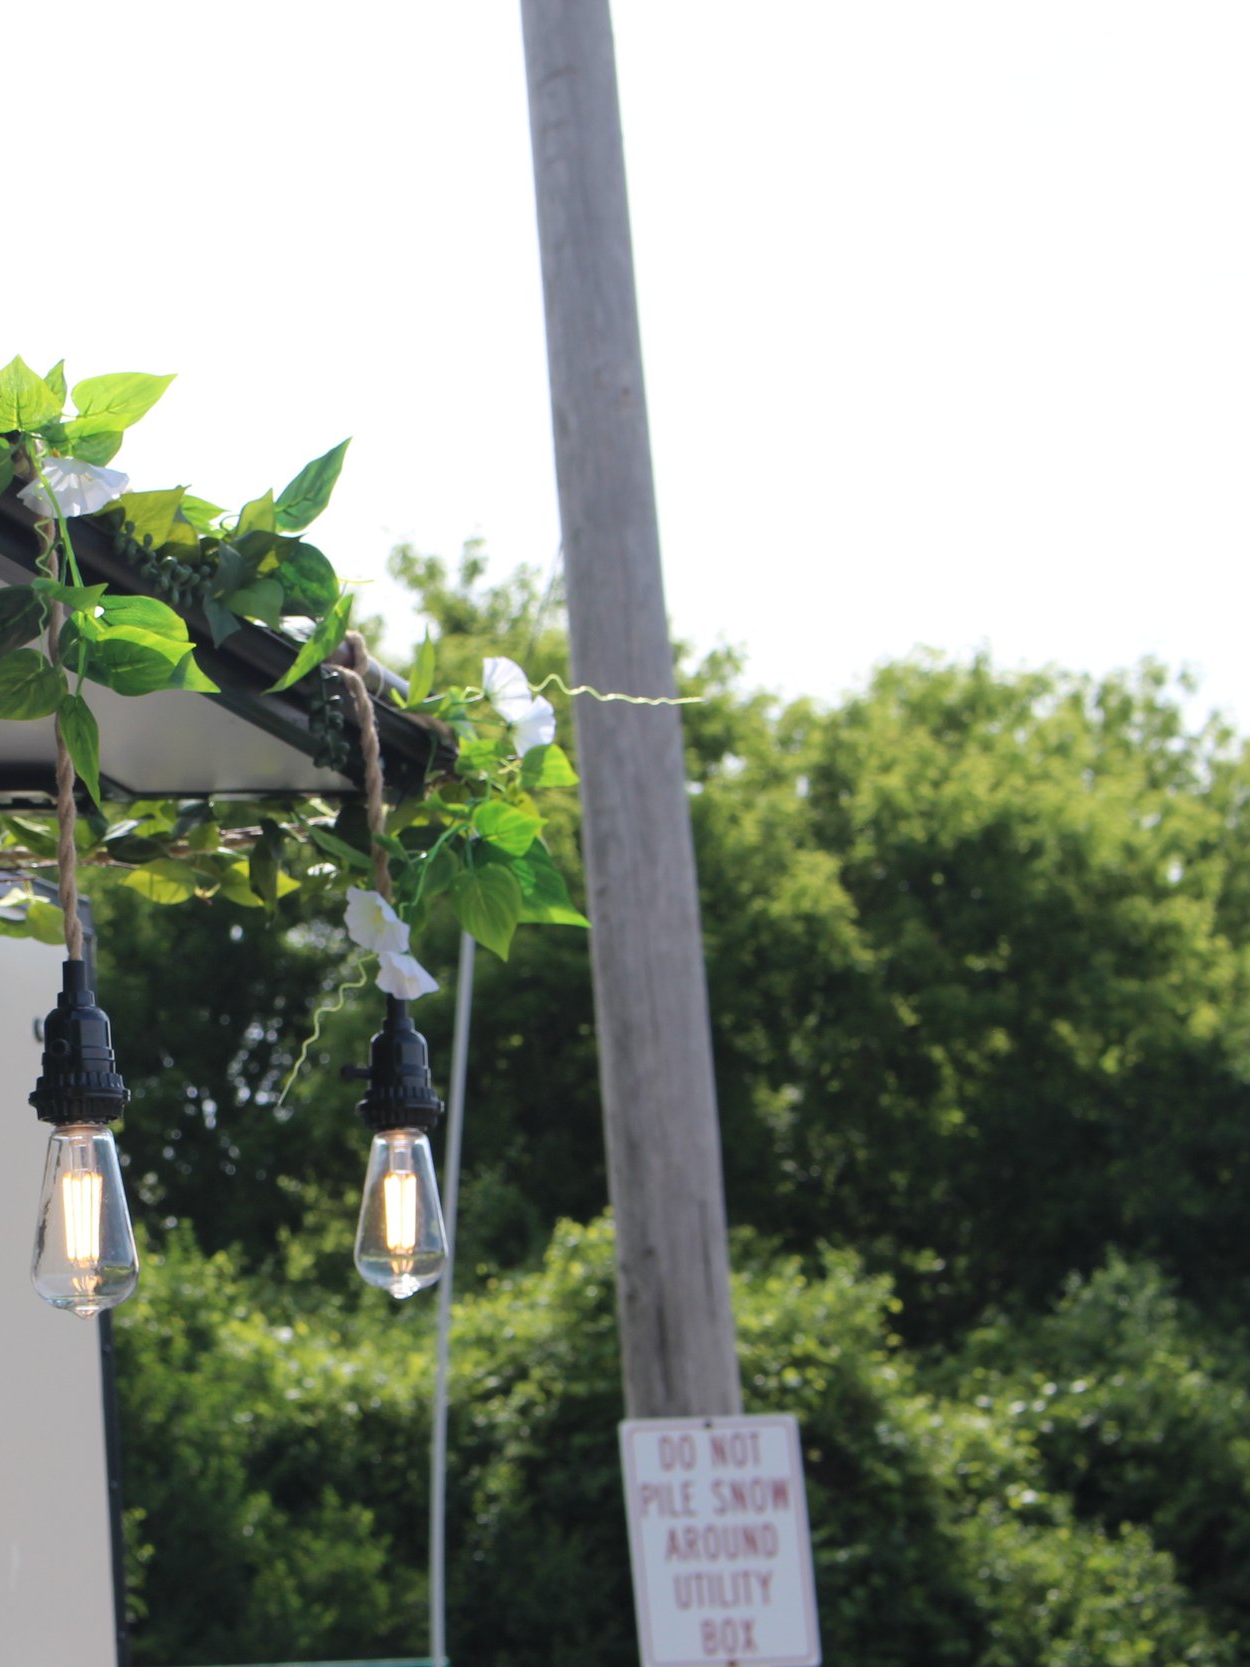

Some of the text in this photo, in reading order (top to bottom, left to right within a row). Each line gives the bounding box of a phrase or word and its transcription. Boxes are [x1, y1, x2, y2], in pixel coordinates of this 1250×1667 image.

[658, 1433, 761, 1471] DO NOT
[640, 1478, 790, 1518] PILE SNOW
[665, 1524, 779, 1563] AROUND
[673, 1571, 773, 1610] UTILITY
[701, 1618, 756, 1656] BOX
